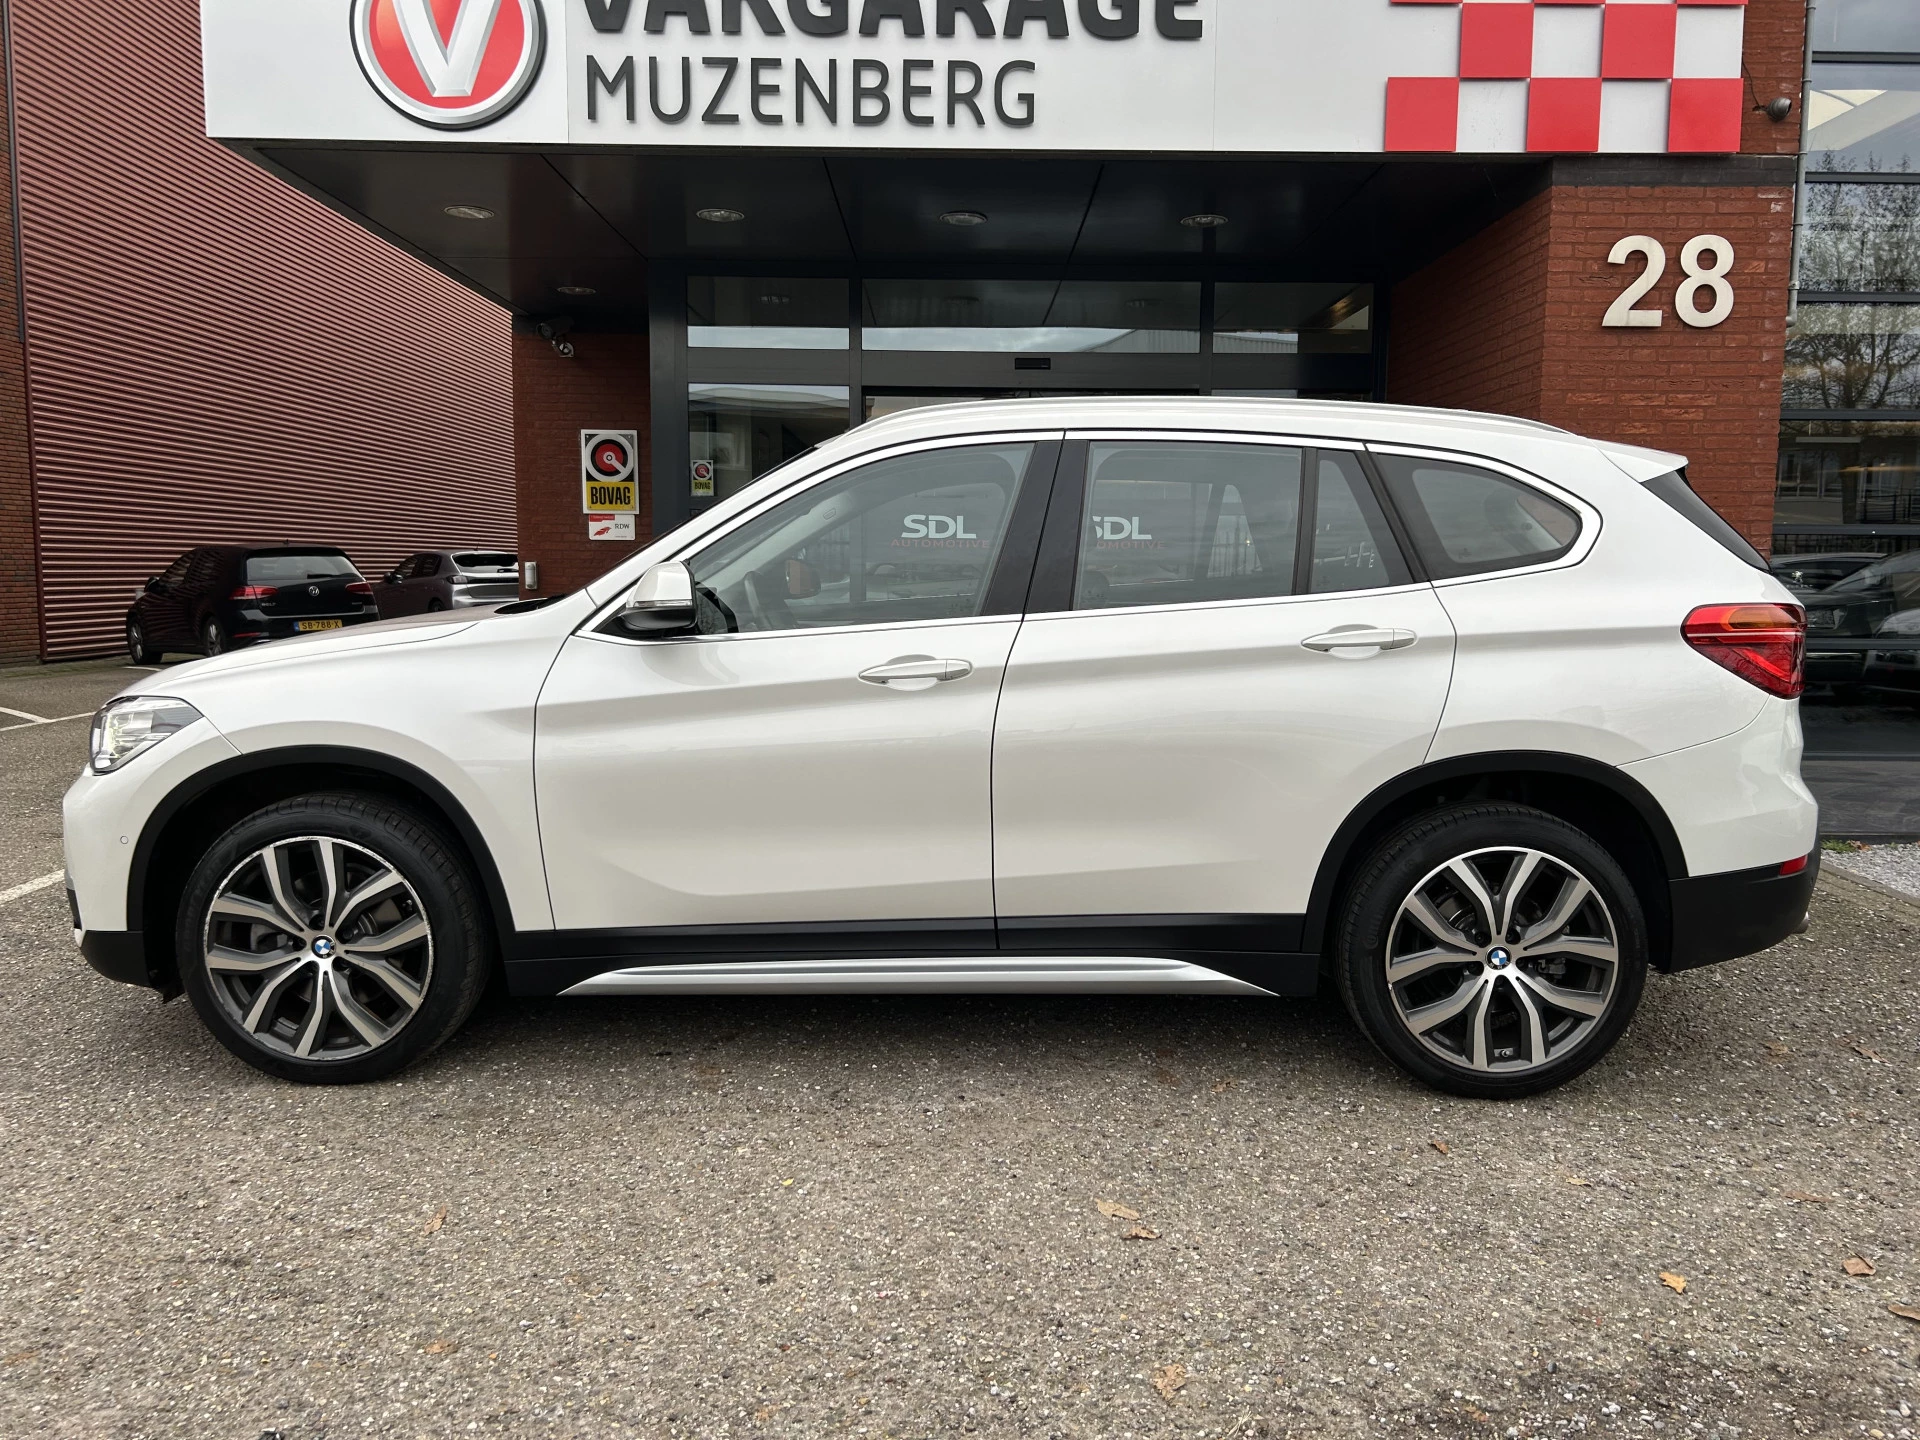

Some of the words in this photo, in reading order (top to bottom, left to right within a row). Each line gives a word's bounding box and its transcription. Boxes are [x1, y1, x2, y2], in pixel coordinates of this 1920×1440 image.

[586, 54, 1036, 127] MUZENBERG
[1601, 234, 1735, 328] 28
[590, 486, 631, 505] BOVAG
[900, 514, 977, 539] SDL
[890, 539, 990, 550] AUTOMOTIVE
